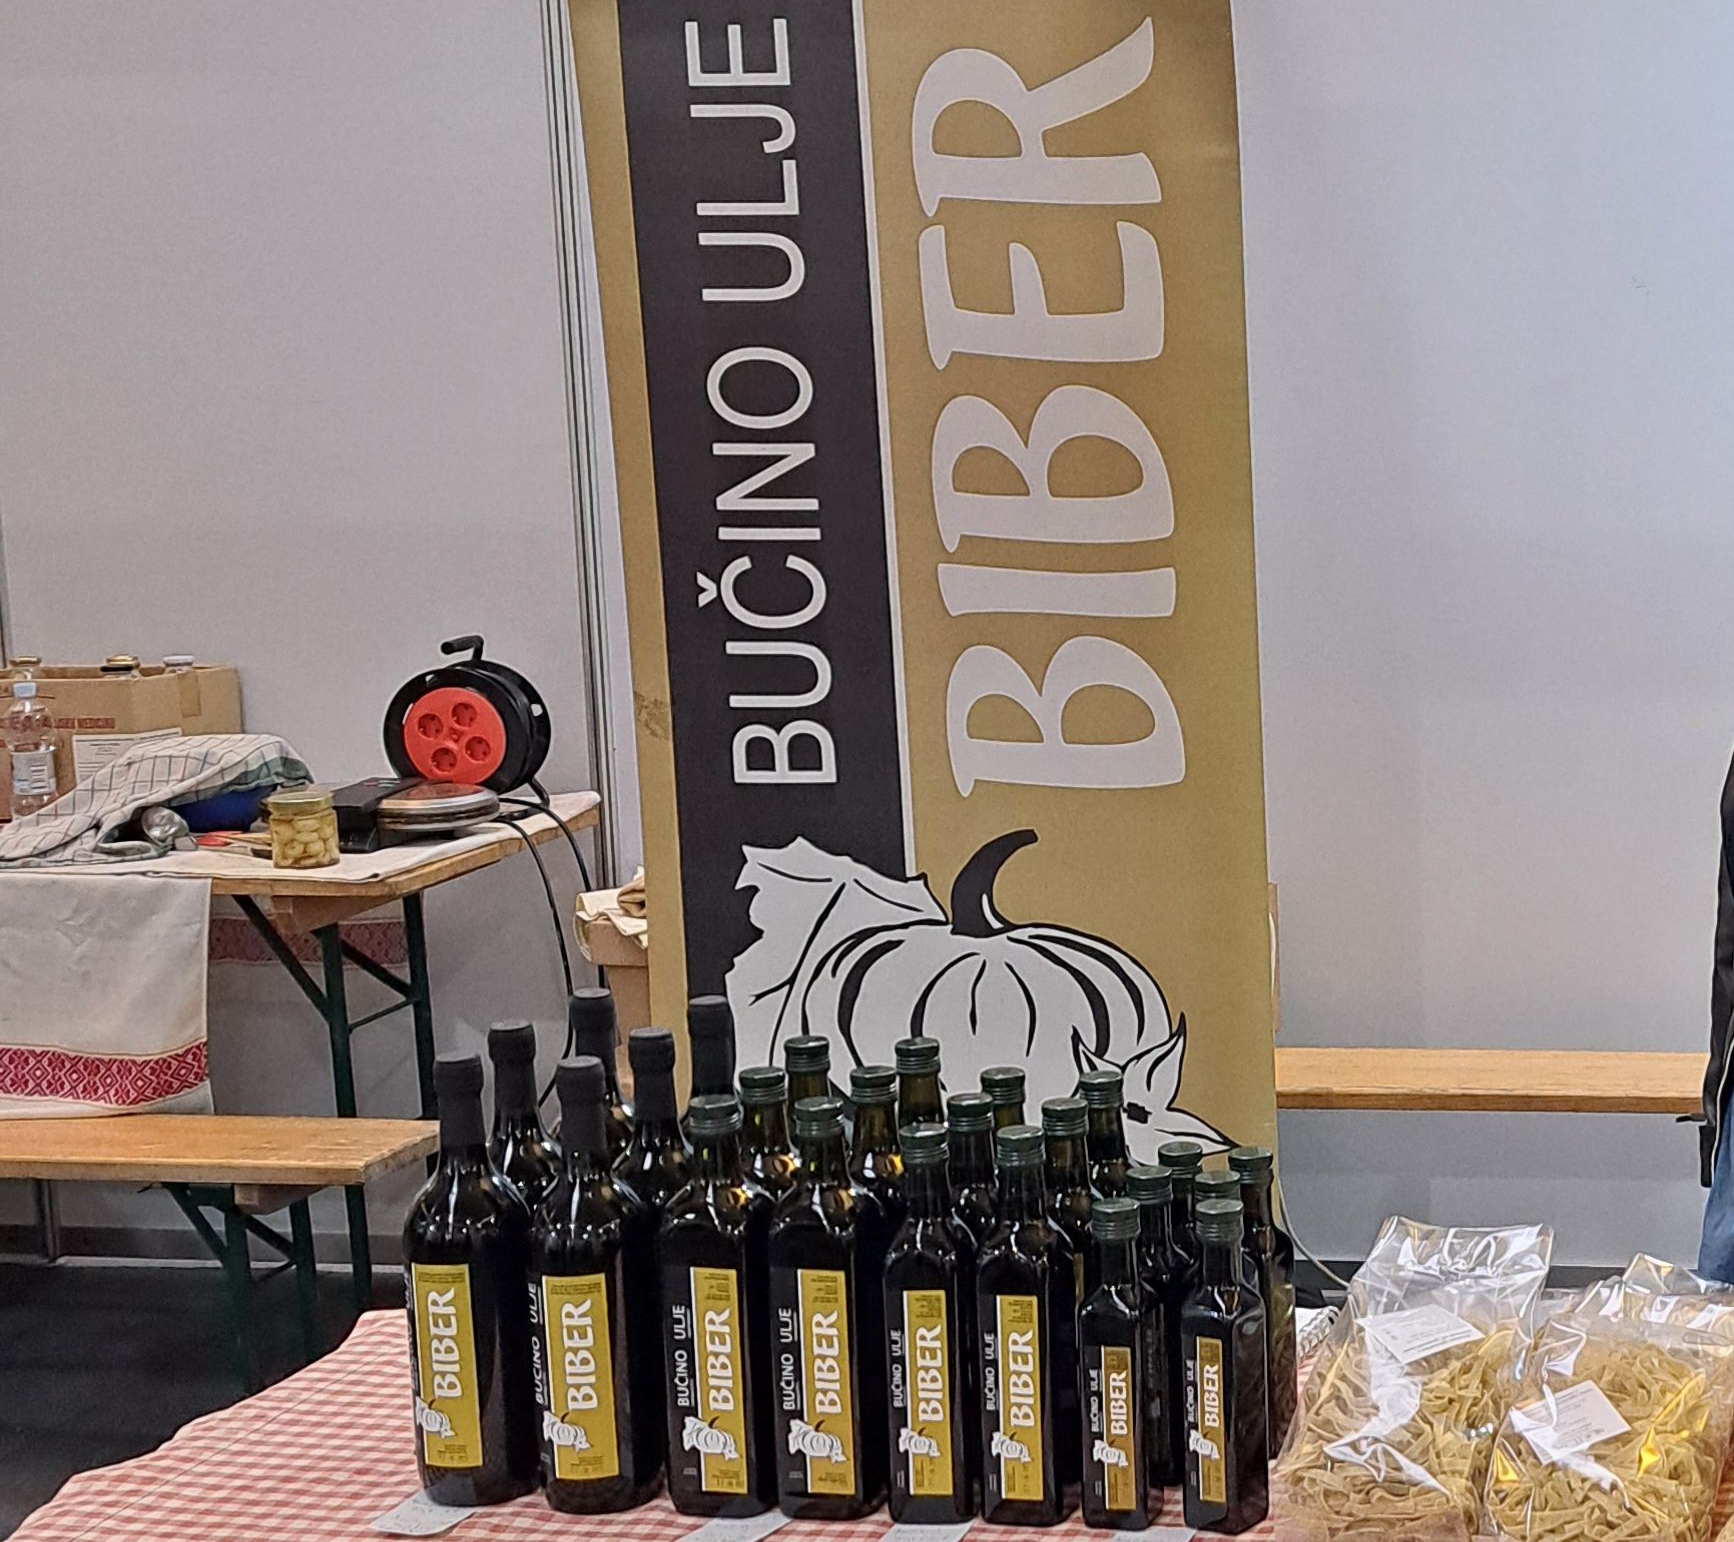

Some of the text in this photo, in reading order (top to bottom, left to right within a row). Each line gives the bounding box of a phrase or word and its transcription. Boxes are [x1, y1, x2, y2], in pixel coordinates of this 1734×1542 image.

[685, 16, 837, 785] BUČINO ULJE
[910, 15, 1187, 798] BIBER
[427, 1286, 462, 1398] BIBER
[560, 1298, 599, 1411] BIBER
[672, 1304, 687, 1340] ULJE
[704, 1308, 735, 1412] BIBER
[778, 1308, 792, 1343] ULJE
[811, 1310, 842, 1415] BIBER
[915, 1324, 944, 1423] BIBER
[1007, 1329, 1035, 1427] BIBER
[1110, 1370, 1128, 1435] BIBER
[1204, 1364, 1219, 1427] BIBER
